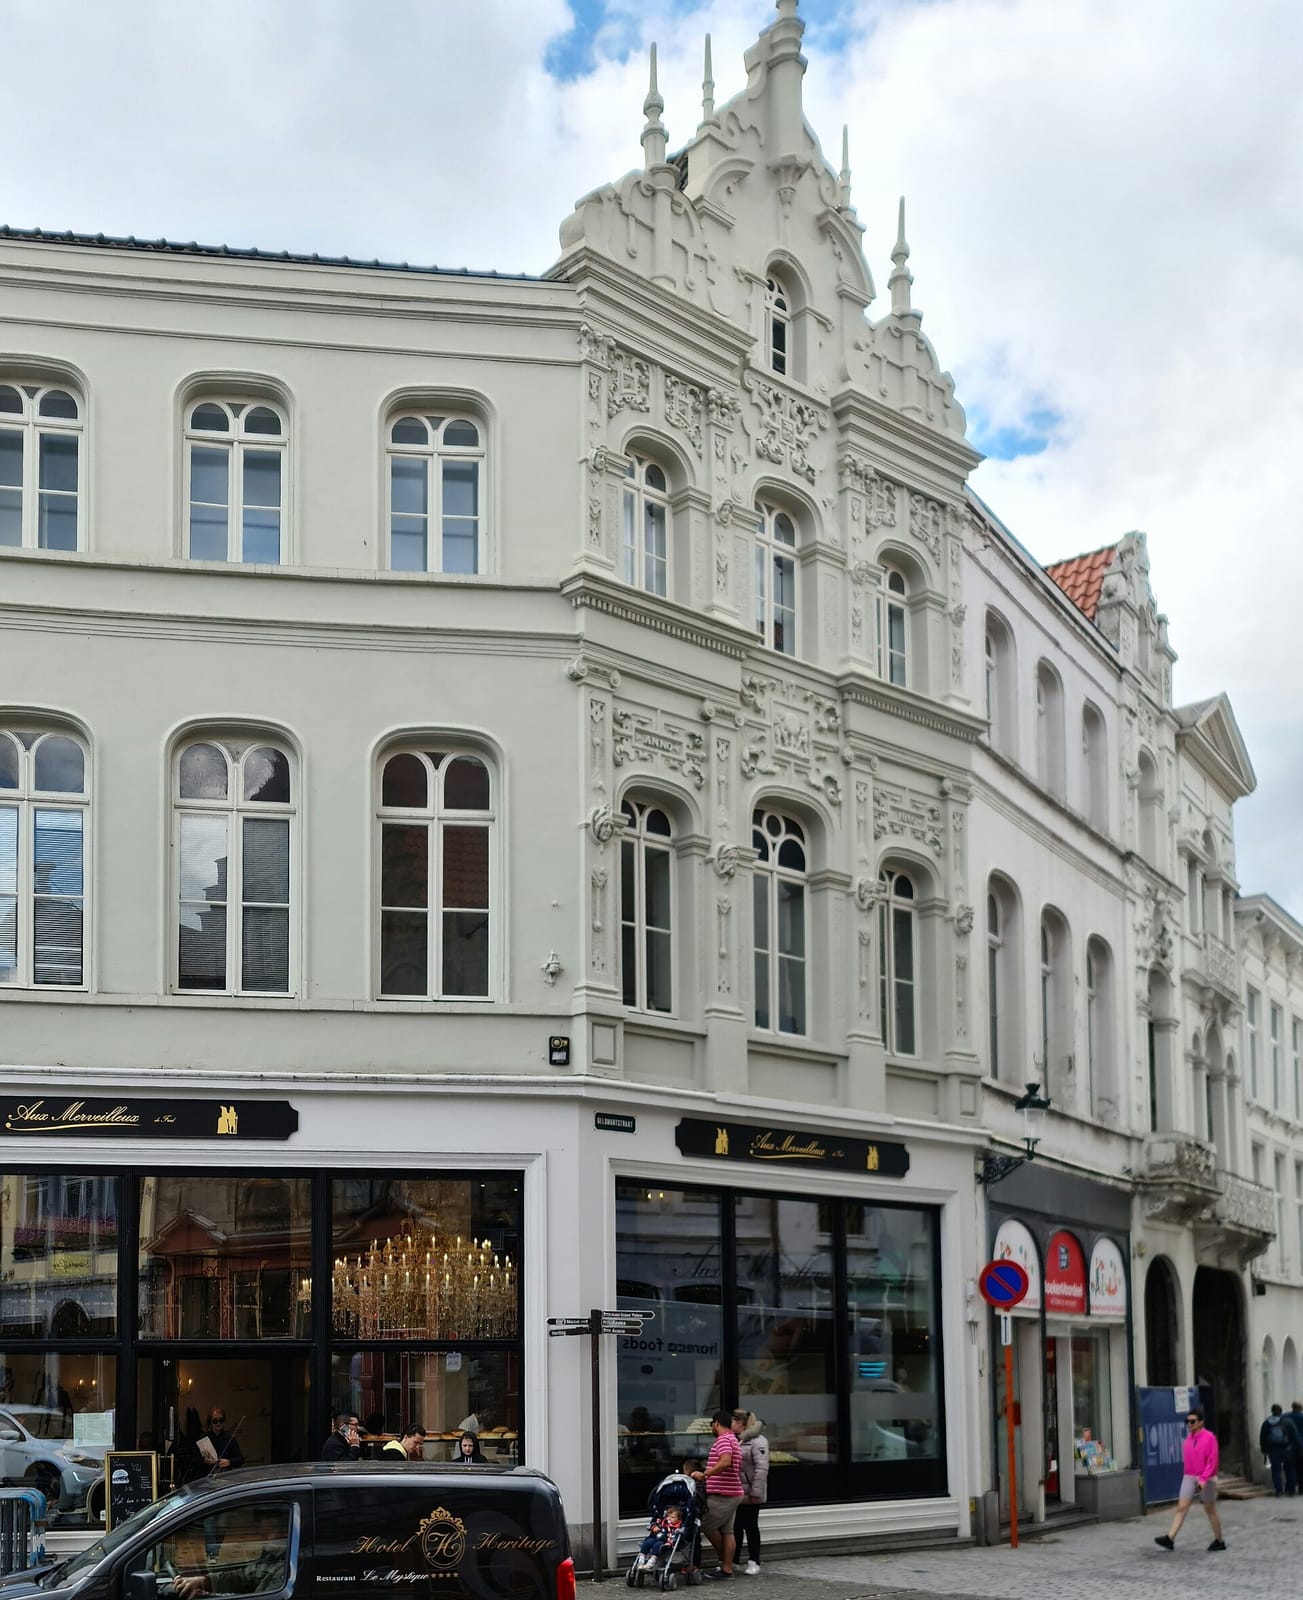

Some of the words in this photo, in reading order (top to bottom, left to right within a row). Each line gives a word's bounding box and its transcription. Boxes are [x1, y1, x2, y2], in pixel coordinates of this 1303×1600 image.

[643, 735, 673, 751] ANNO
[8, 1100, 48, 1121] Aux
[51, 1101, 140, 1123] Merveilleux
[751, 1131, 775, 1150] Aux
[775, 1134, 826, 1156] Merveilleux
[351, 1535, 417, 1554] Hotel
[472, 1531, 558, 1554] Heritage
[316, 1574, 356, 1582] Restaurant
[360, 1569, 378, 1582] Le
[379, 1569, 430, 1584] Mystique
